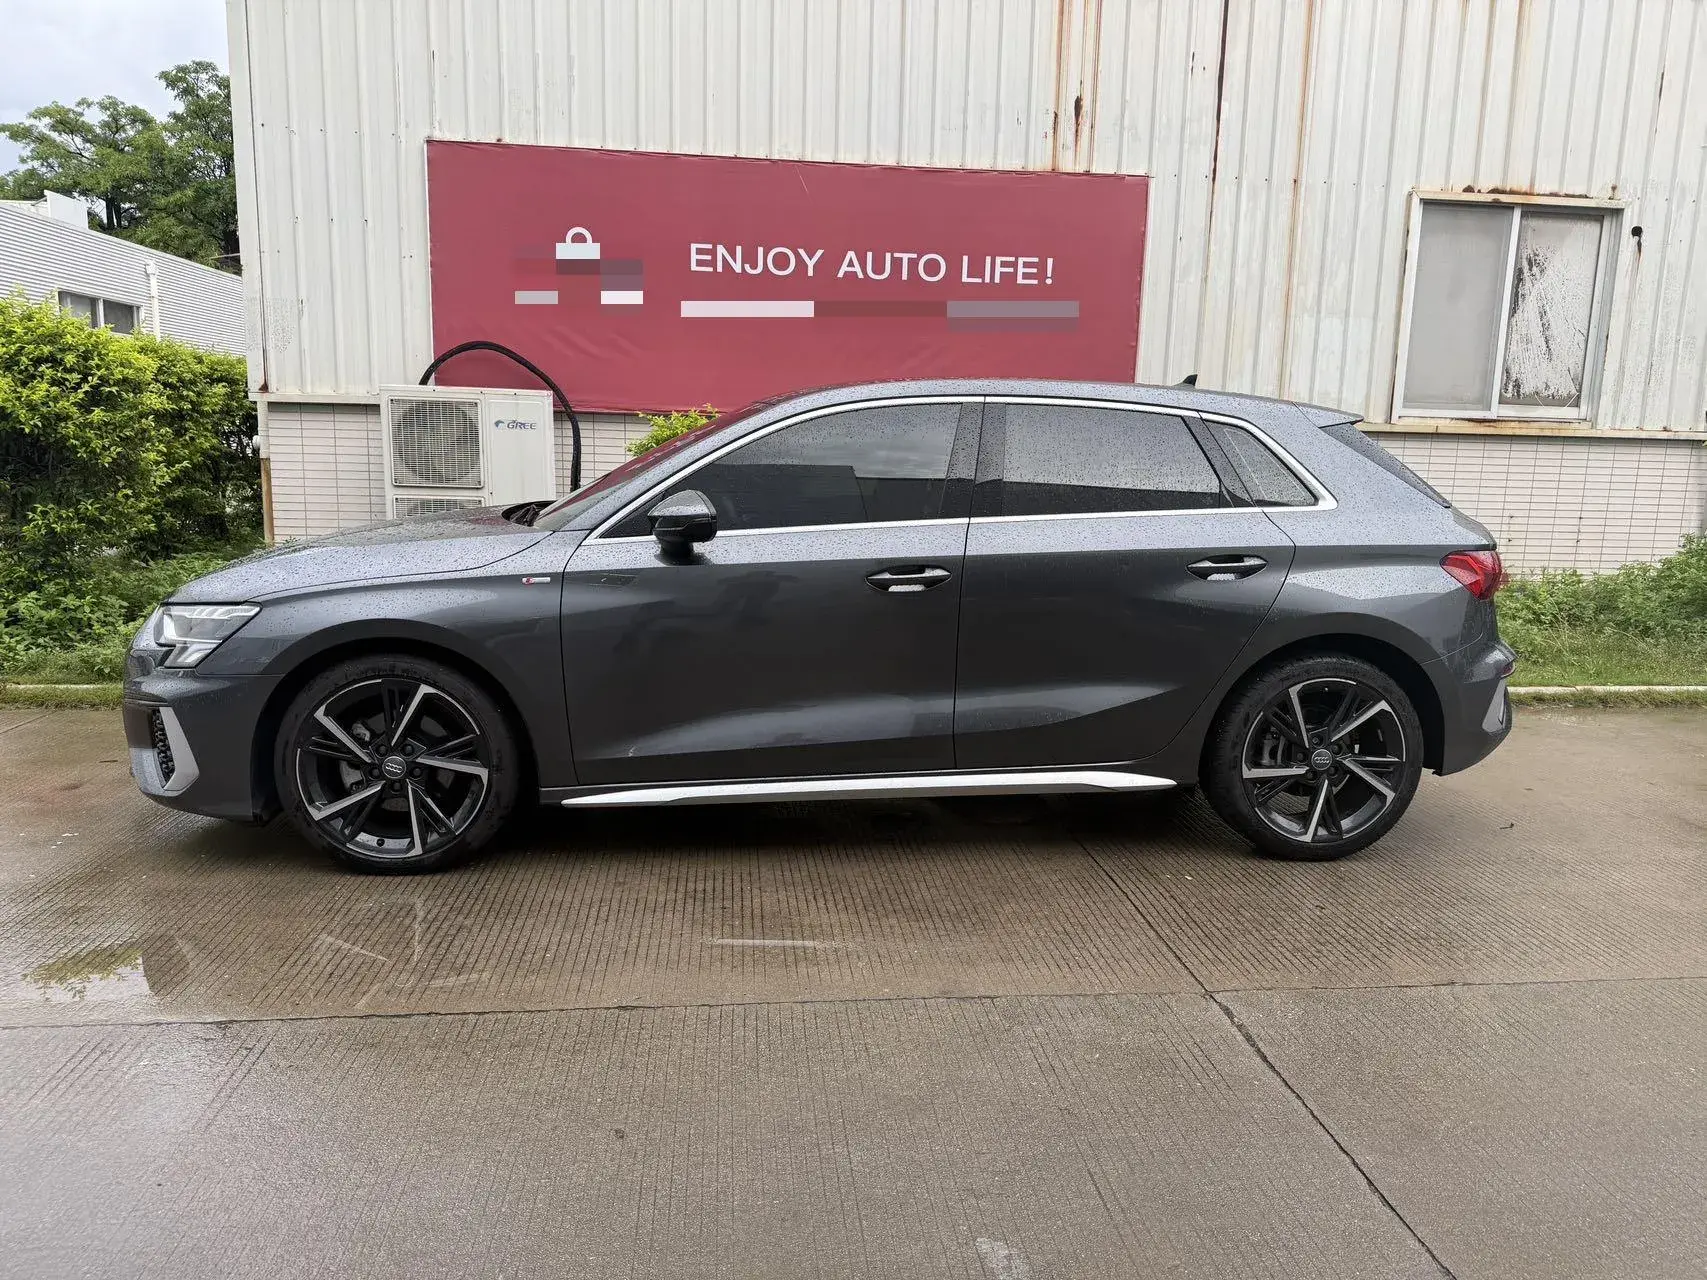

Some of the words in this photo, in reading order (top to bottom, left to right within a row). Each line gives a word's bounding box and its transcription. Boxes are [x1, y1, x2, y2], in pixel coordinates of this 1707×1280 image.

[690, 243, 824, 276] ENJOY
[837, 250, 946, 281] AUTO
[961, 255, 1054, 285] LIFE!
[507, 420, 537, 430] GREE
